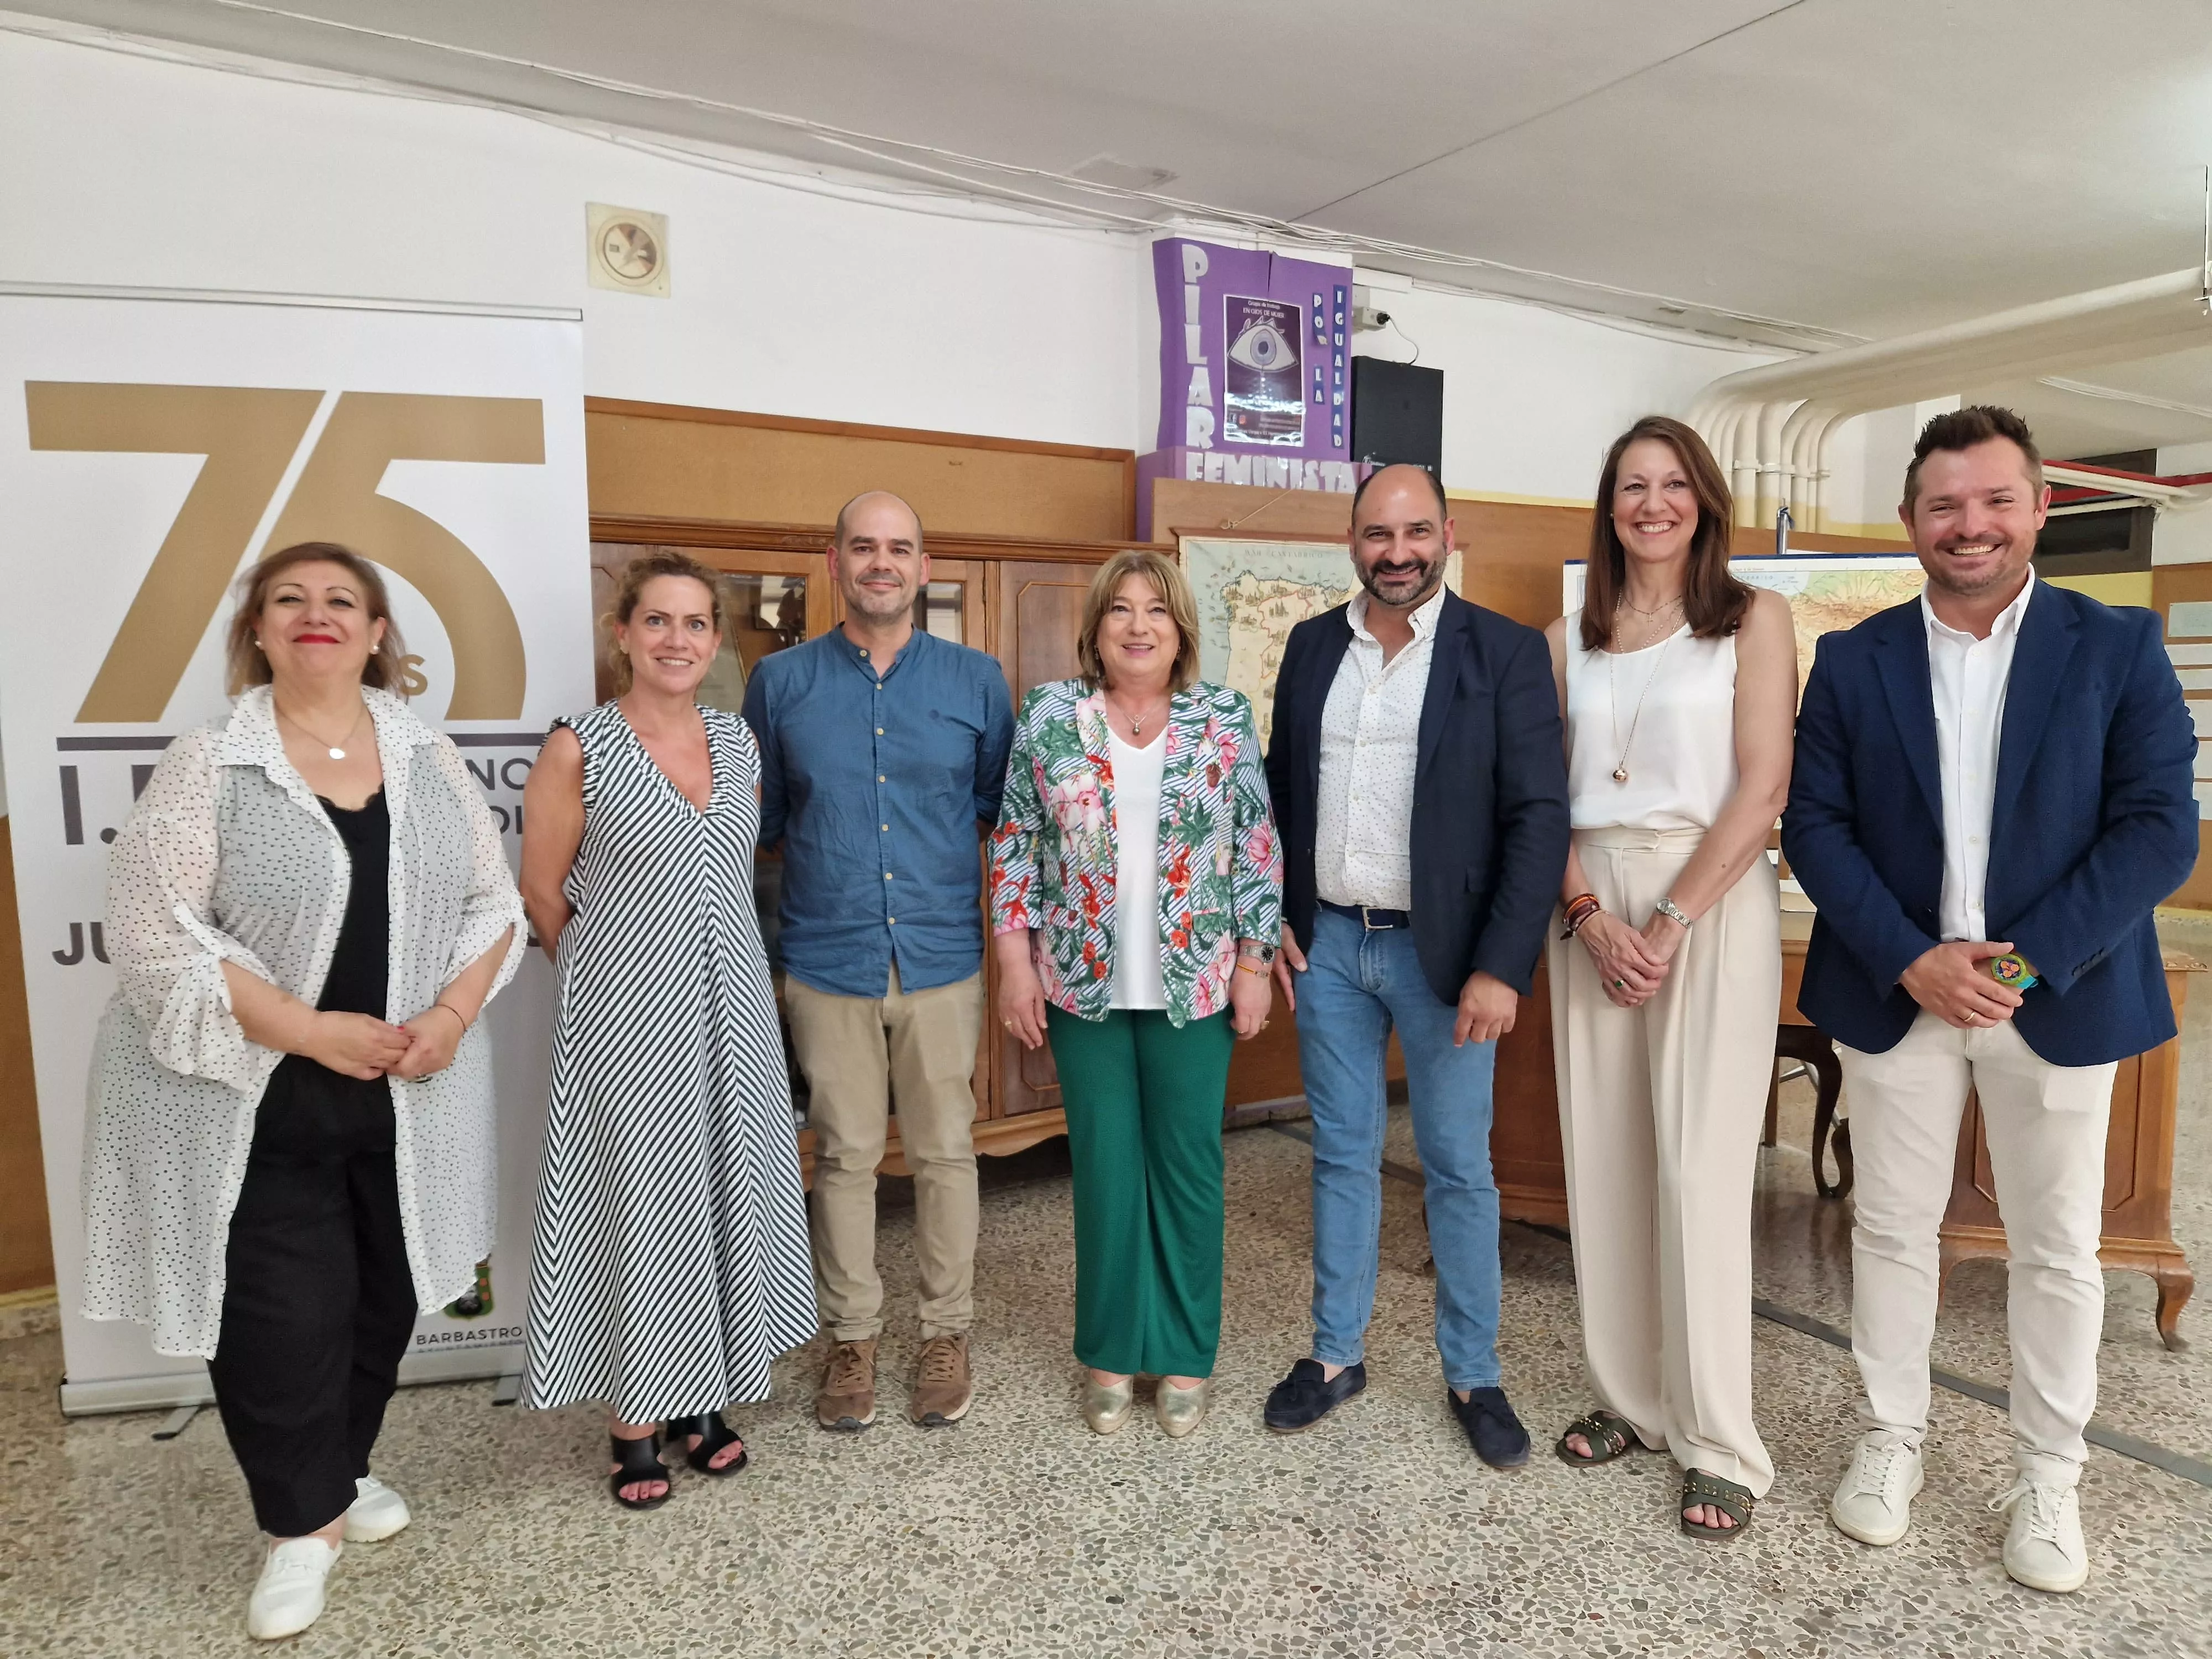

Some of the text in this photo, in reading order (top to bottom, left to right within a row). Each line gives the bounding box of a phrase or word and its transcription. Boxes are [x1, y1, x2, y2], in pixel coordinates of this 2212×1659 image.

[1182, 244, 1215, 448] PILAR
[1315, 368, 1323, 402] LA
[1333, 291, 1344, 446] IGUALDAD
[1186, 451, 1357, 494] FEMINISTA
[25, 380, 545, 723] 75
[416, 1327, 523, 1345] BARBASTRO
